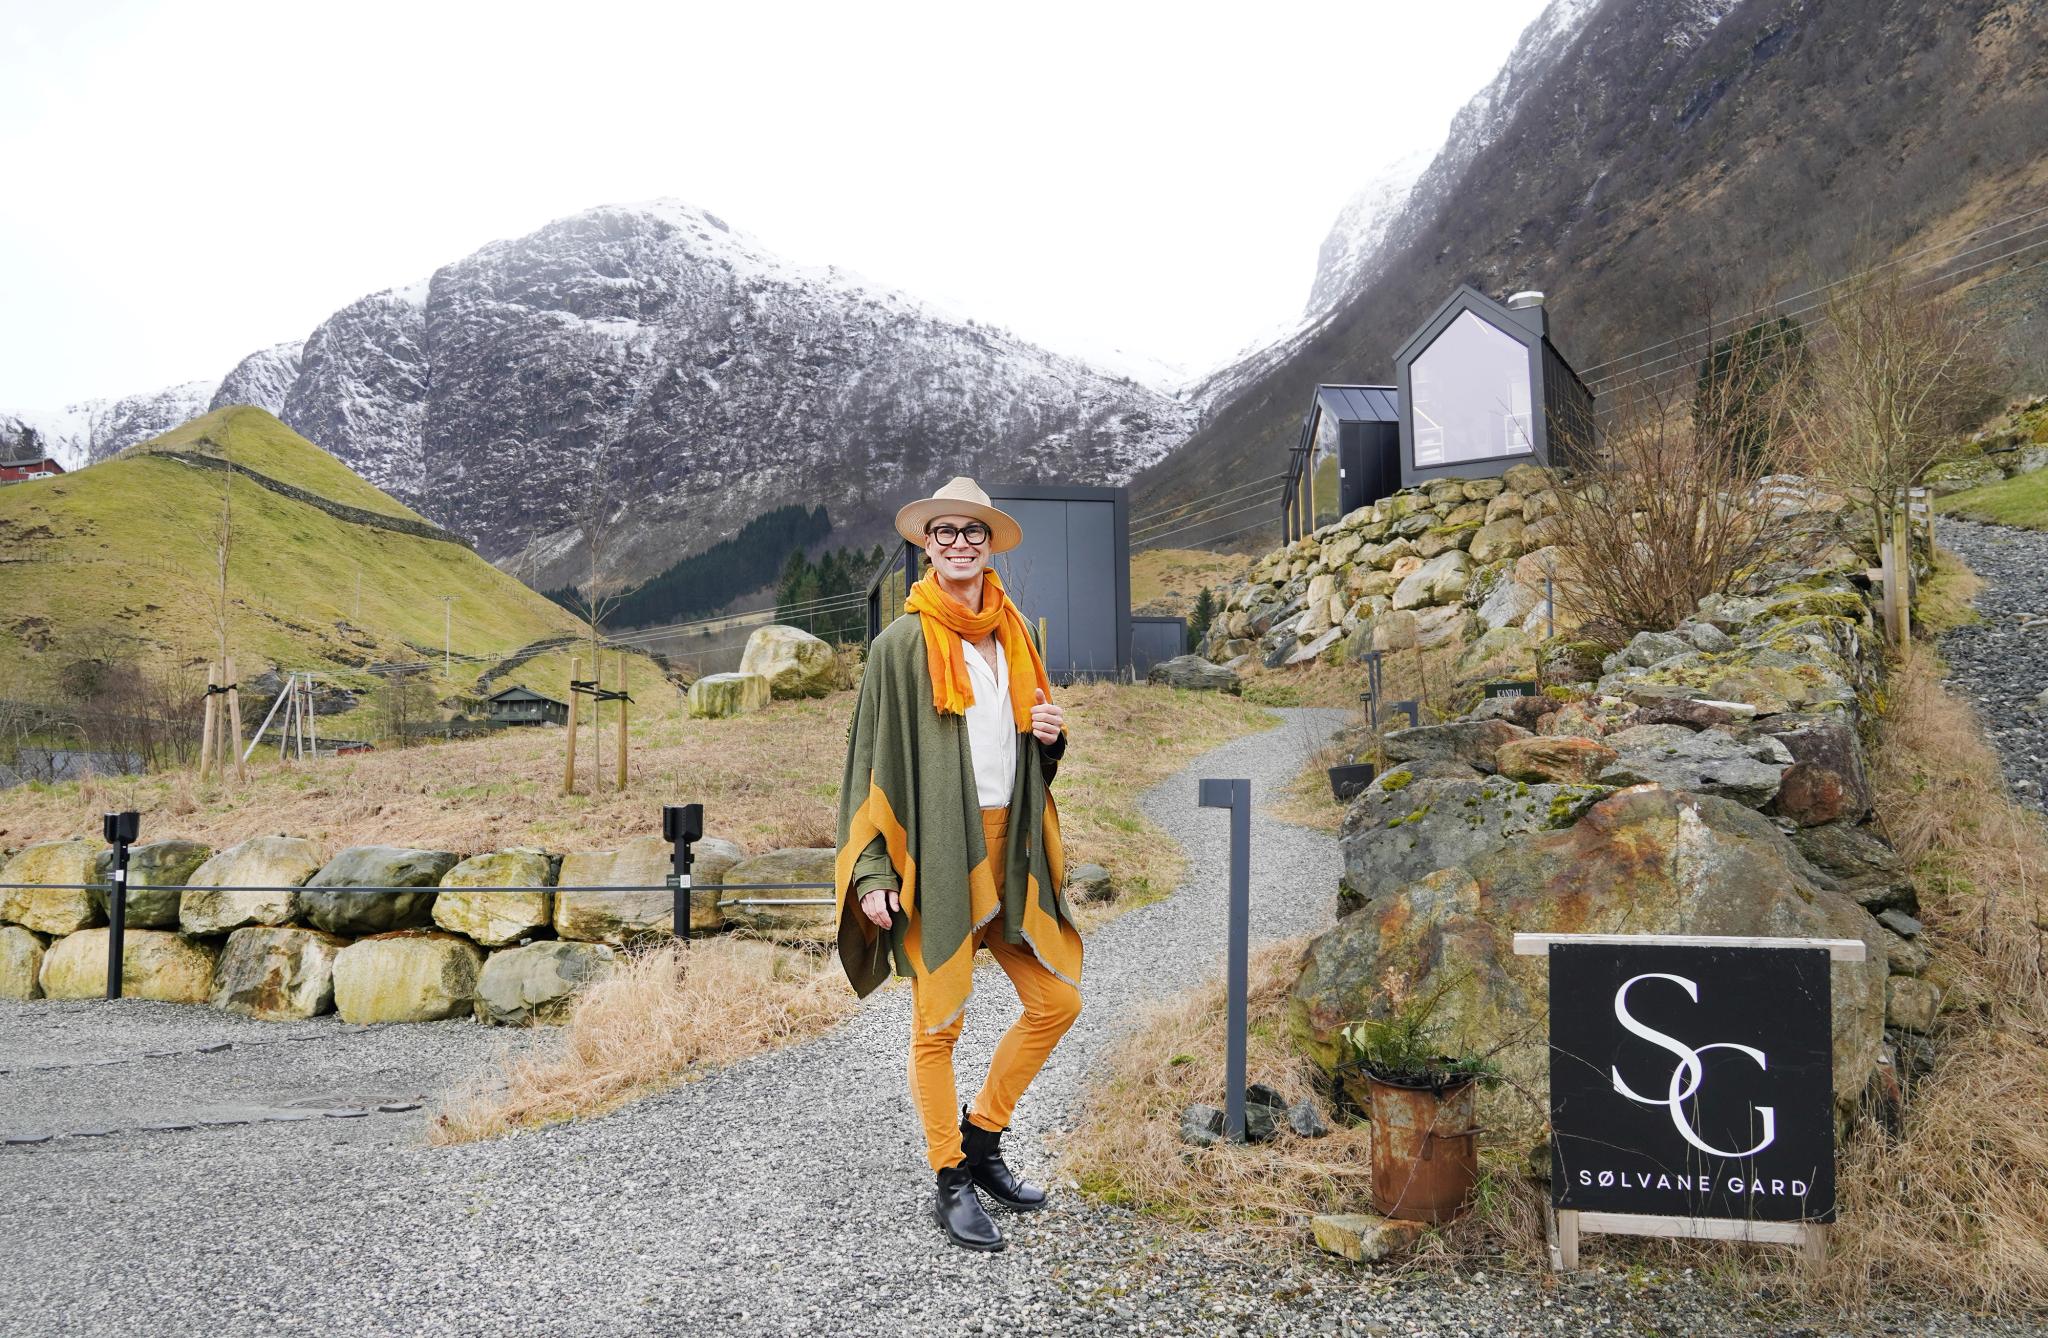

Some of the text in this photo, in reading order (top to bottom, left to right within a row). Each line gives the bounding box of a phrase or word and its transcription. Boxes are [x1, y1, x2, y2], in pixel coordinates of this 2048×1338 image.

[1611, 973, 1775, 1157] SG
[1579, 1169, 1807, 1197] SØLVANE GARD
